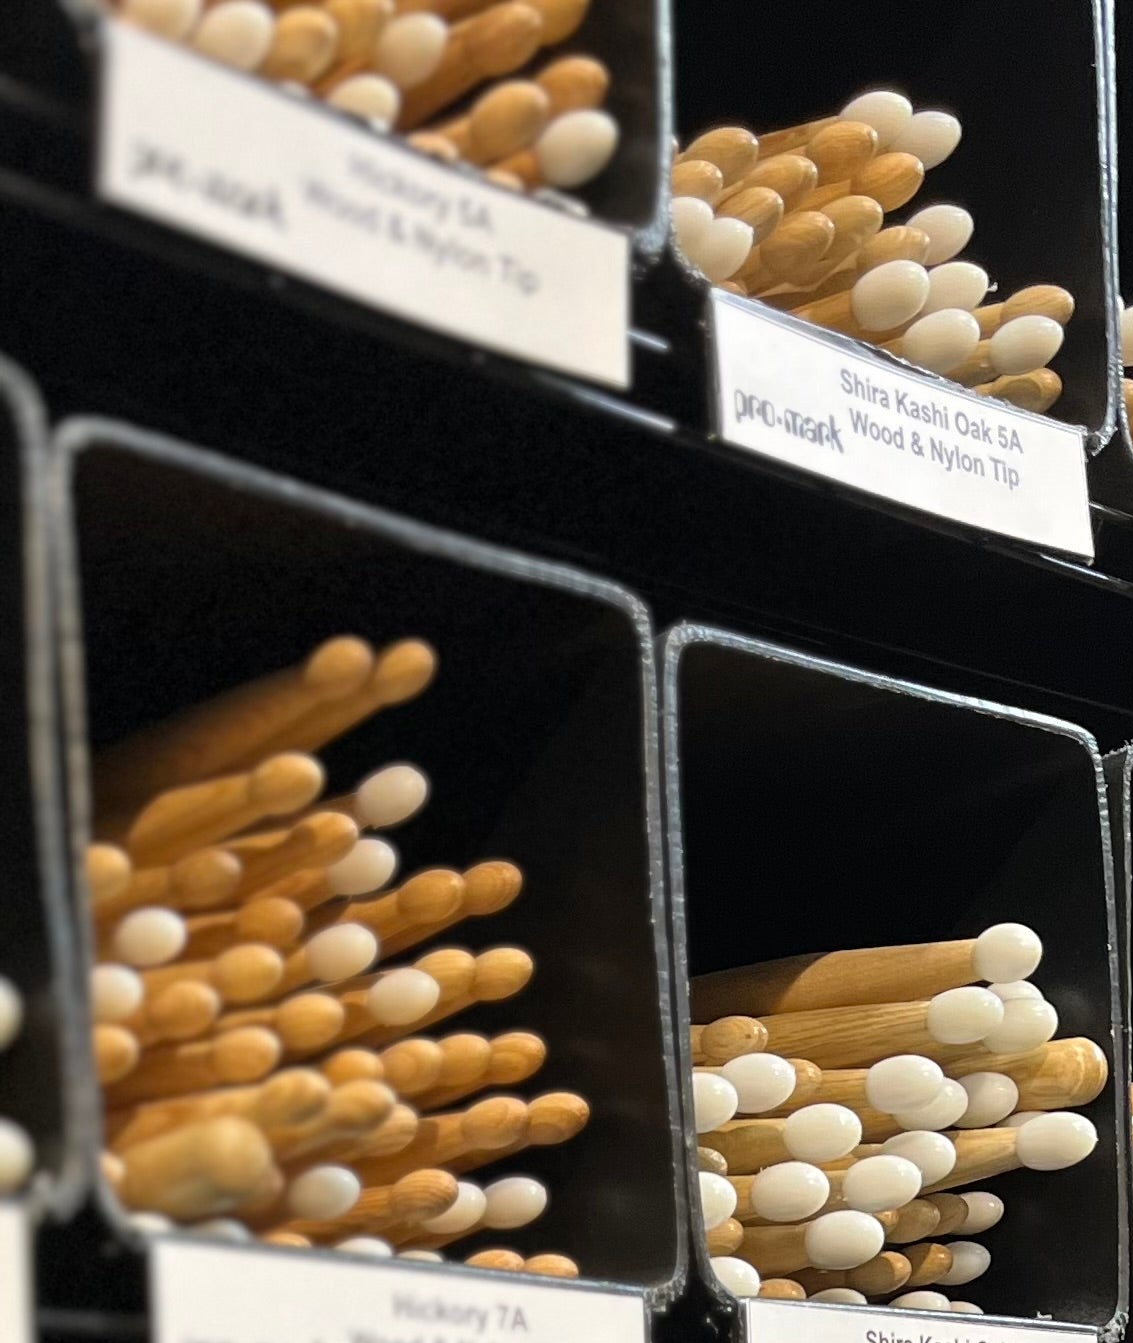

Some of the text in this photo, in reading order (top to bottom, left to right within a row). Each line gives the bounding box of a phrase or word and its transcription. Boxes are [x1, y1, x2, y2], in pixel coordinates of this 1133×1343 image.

[840, 368, 1025, 454] Shira Kashi Oak 5A
[849, 408, 1021, 490] Wood & Nylon Tip
[393, 1291, 528, 1333] Hickory 7A
